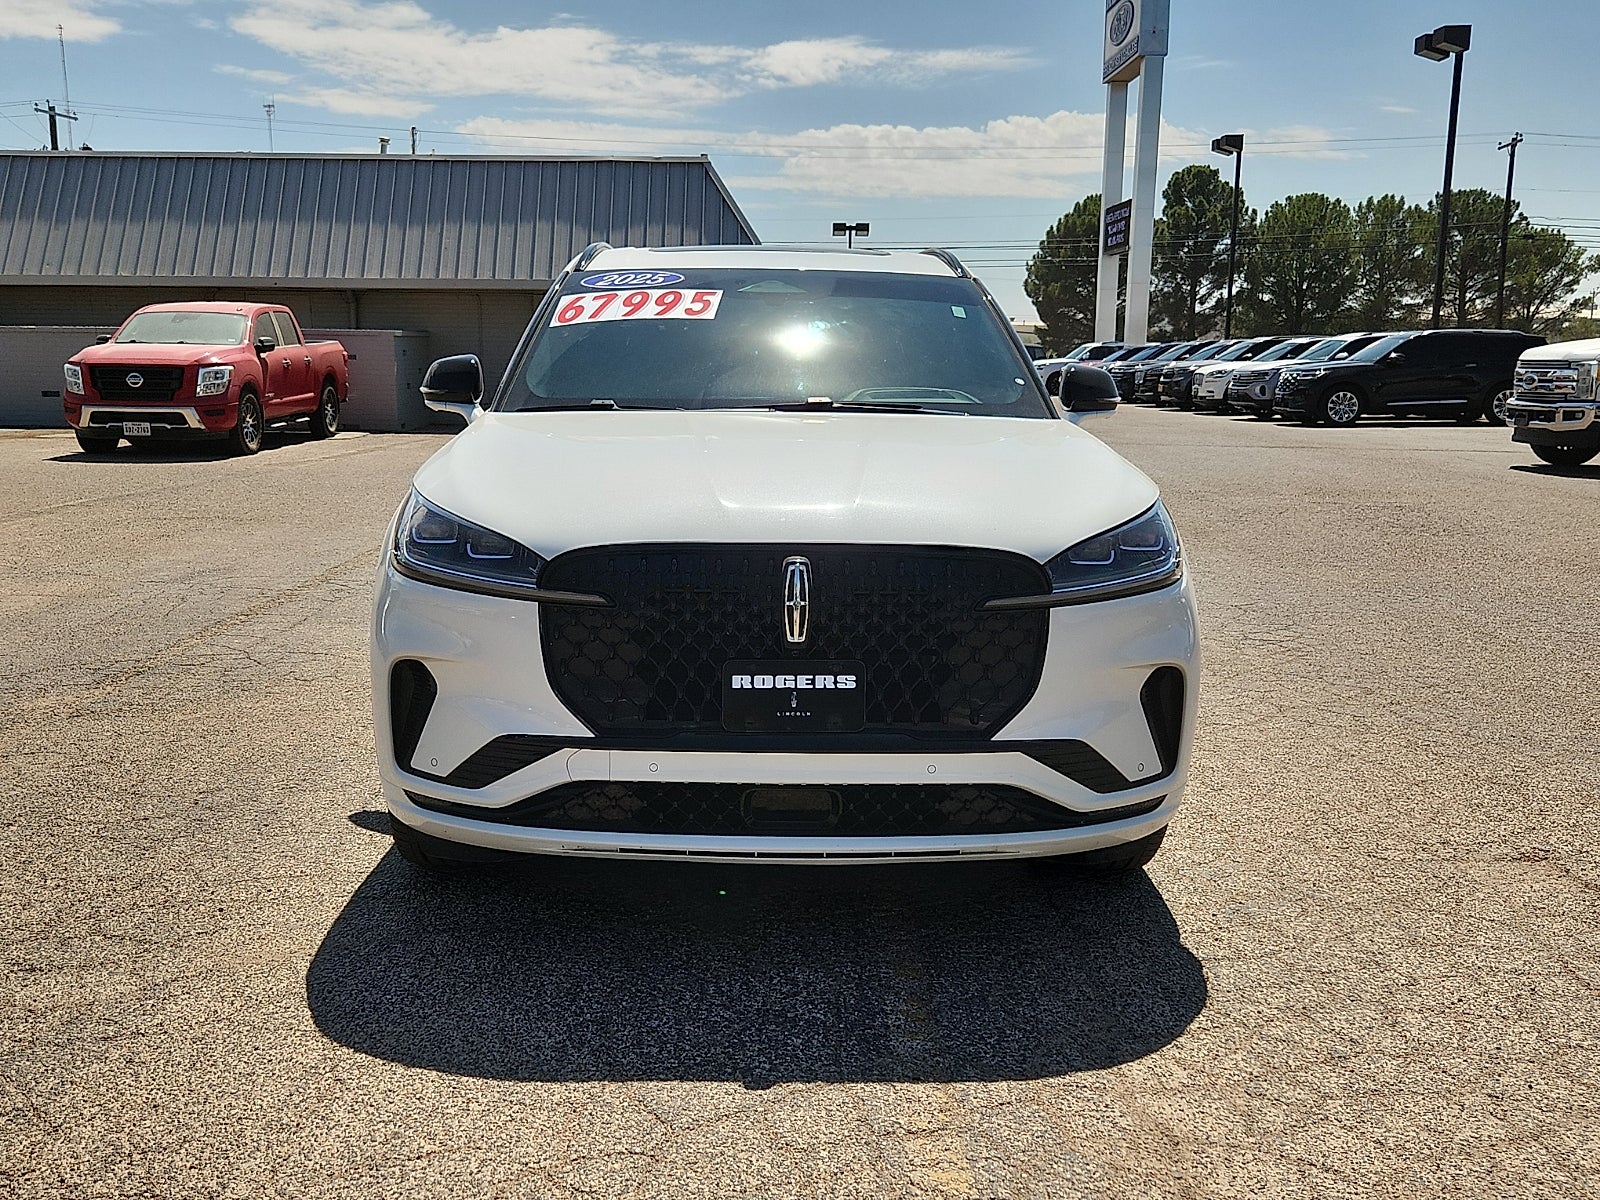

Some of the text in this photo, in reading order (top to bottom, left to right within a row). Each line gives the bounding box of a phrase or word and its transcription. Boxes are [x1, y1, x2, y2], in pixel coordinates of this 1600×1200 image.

[595, 273, 671, 287] 2025
[556, 290, 718, 324] 67995
[731, 675, 857, 689] ROGERS
